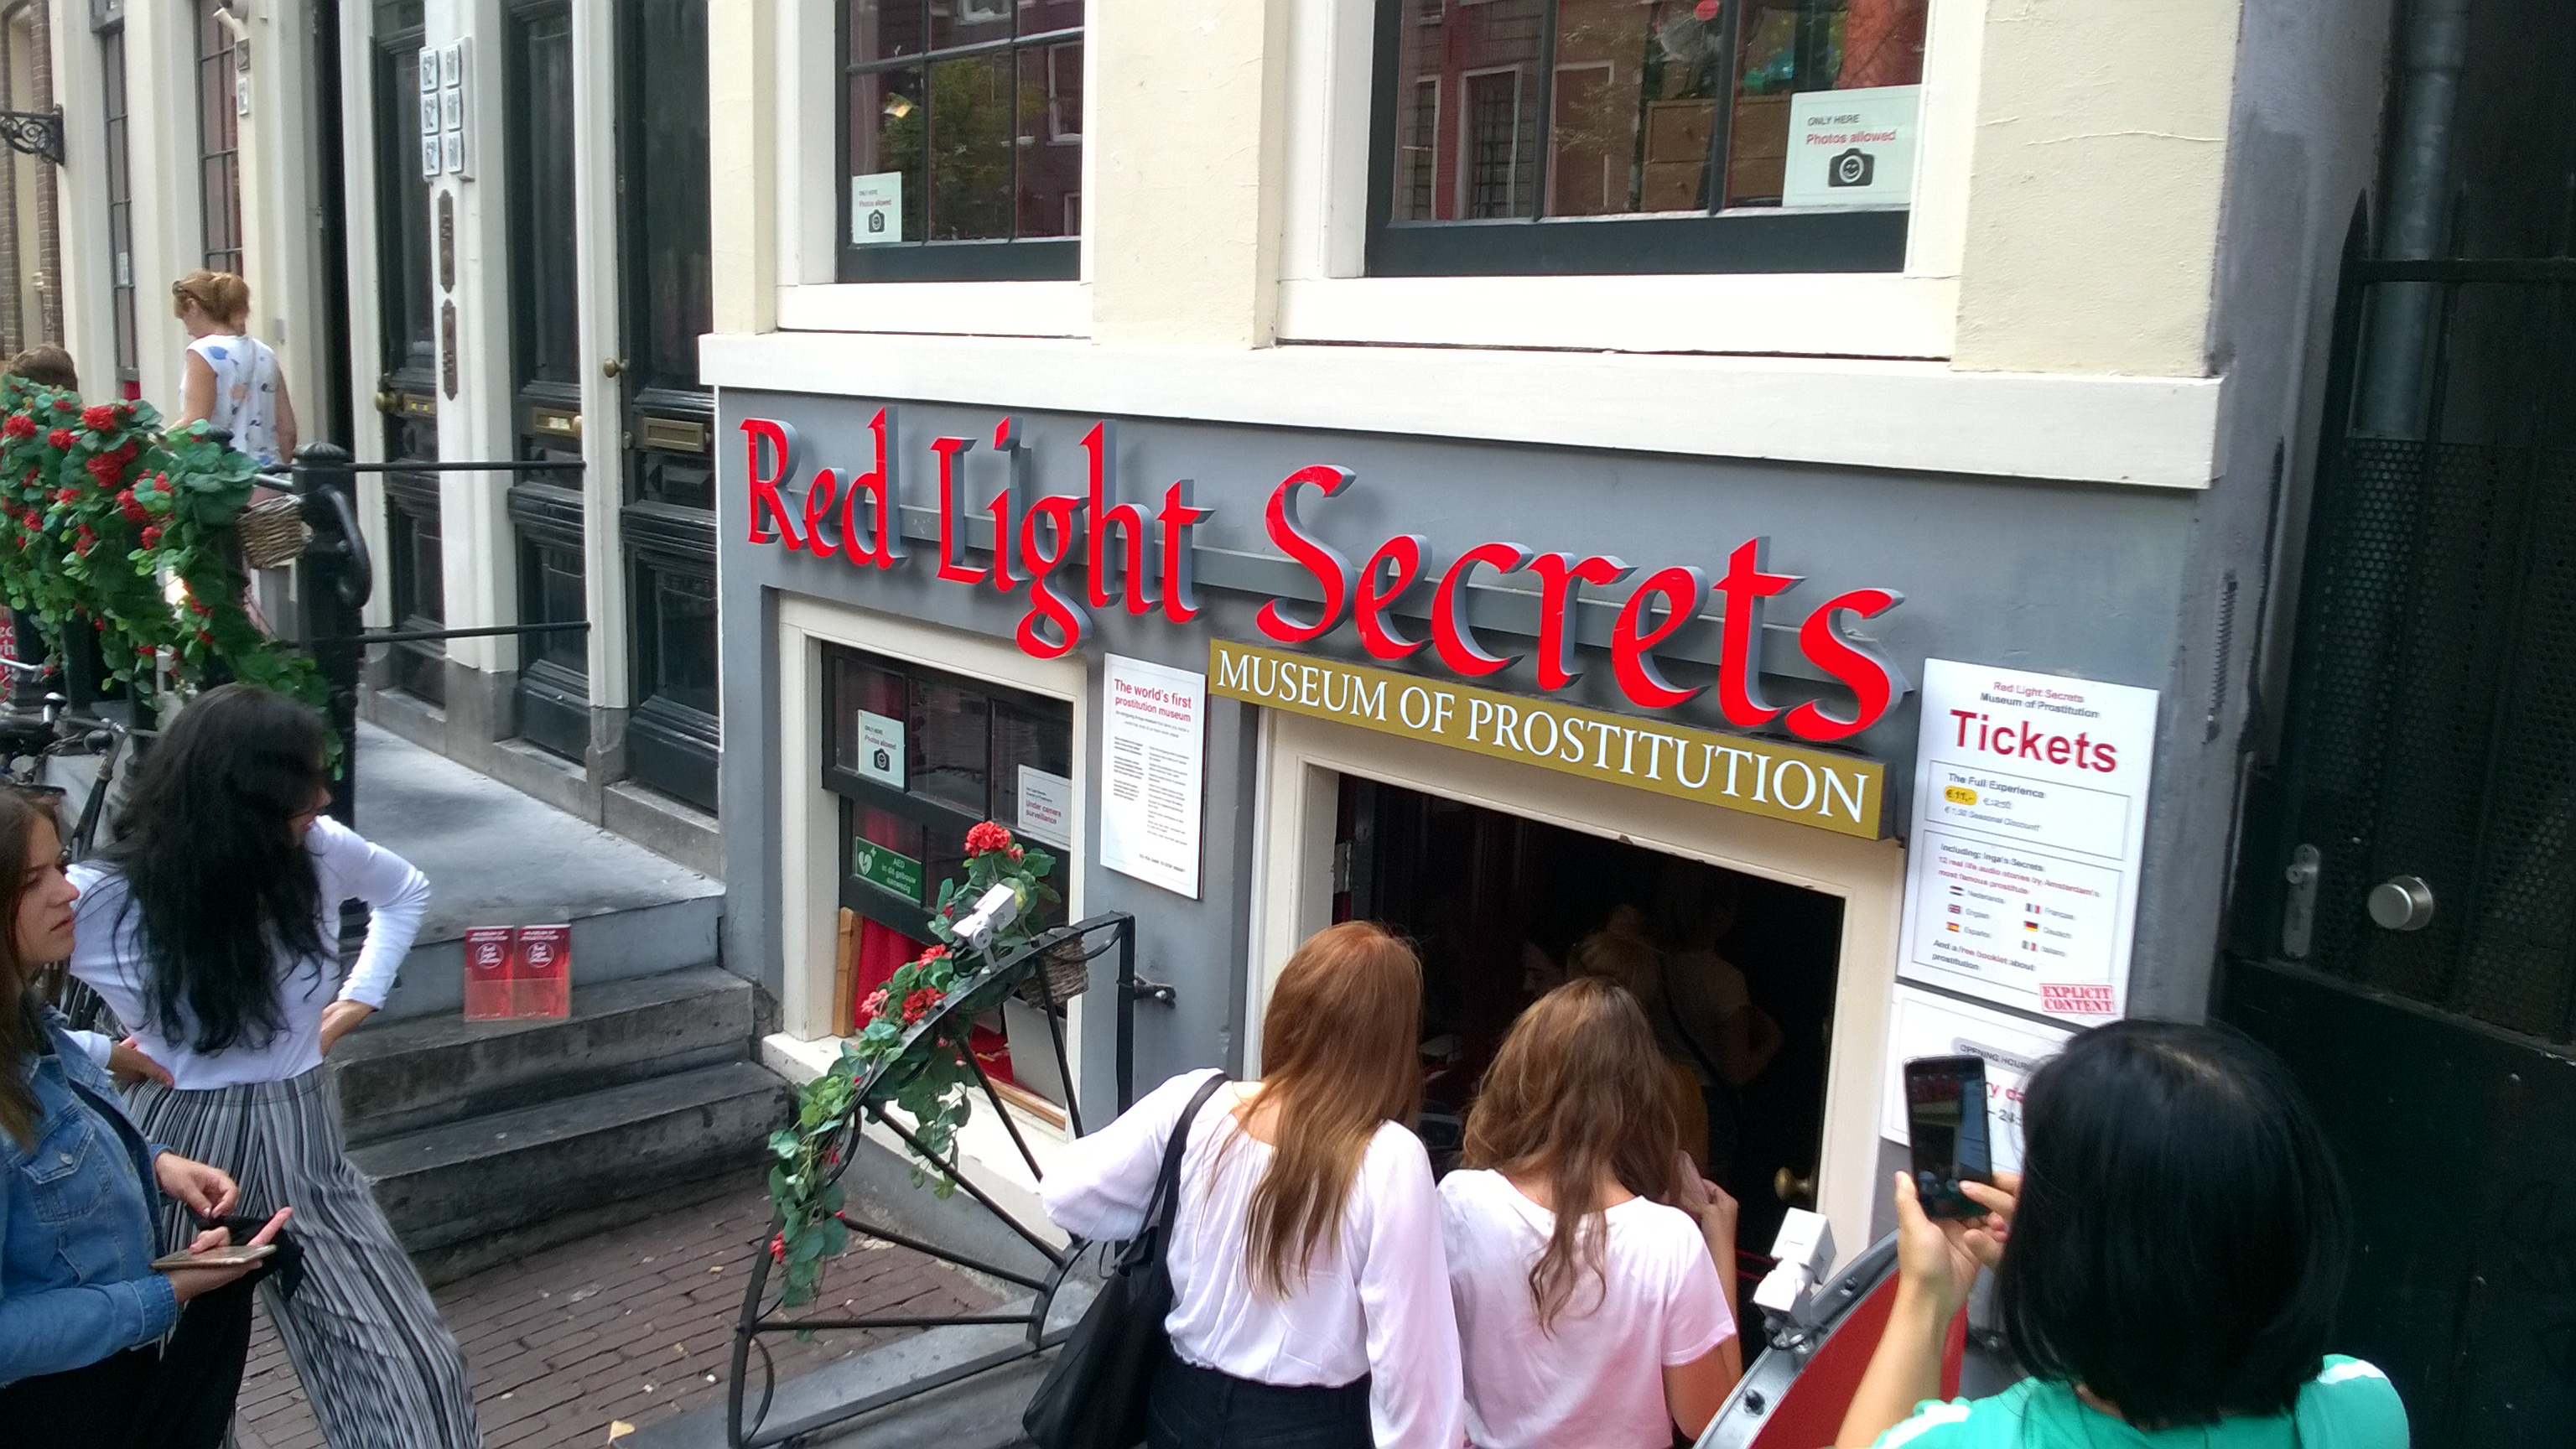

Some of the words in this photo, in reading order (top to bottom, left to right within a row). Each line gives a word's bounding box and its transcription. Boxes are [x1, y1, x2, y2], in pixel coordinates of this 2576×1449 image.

[1807, 116, 1831, 126] ONLY
[1833, 114, 1860, 124] HERE
[1806, 133, 1847, 144] Photos
[1850, 129, 1897, 143] allowed
[740, 406, 901, 570] Red
[930, 415, 1206, 660] Light
[1255, 464, 1900, 741] Secrets
[1114, 678, 1132, 694] The
[1134, 685, 1170, 704] world's
[1171, 692, 1192, 709] first
[1993, 681, 2014, 693] Red
[2016, 684, 2043, 698] Light
[2044, 689, 2085, 703] Secrets
[1115, 697, 1157, 714] prostitution
[1159, 707, 1191, 723] museum
[1980, 693, 2022, 707] Museum
[2025, 699, 2036, 709] of
[2038, 701, 2100, 719] Prostitution
[1217, 649, 1388, 722] MUSEUM
[1399, 686, 1456, 734] OF
[1466, 698, 1869, 823] PROSTITUTION
[1950, 709, 2117, 773] Tickets
[1948, 772, 1966, 783] The
[1968, 776, 1987, 787] Full
[1989, 781, 2046, 799] Experience
[893, 857, 906, 870] AED
[1941, 843, 1981, 860] Including:
[1984, 851, 2009, 864] Inga's
[2011, 858, 2044, 872] Secrets
[1939, 869, 1958, 880] most
[1959, 873, 1988, 886] famous
[1950, 860, 1964, 868] real
[1979, 865, 2001, 875] audio
[2002, 870, 2030, 882] stories
[1932, 953, 1980, 971] prostitution
[1933, 939, 1950, 950] And
[1959, 945, 1975, 957] free
[1976, 950, 2007, 965] booklet
[2009, 959, 2035, 972] about
[2042, 986, 2110, 999] EXPLICIT
[2044, 998, 2111, 1011] CONTENT
[1960, 1044, 2000, 1062] OPENING
